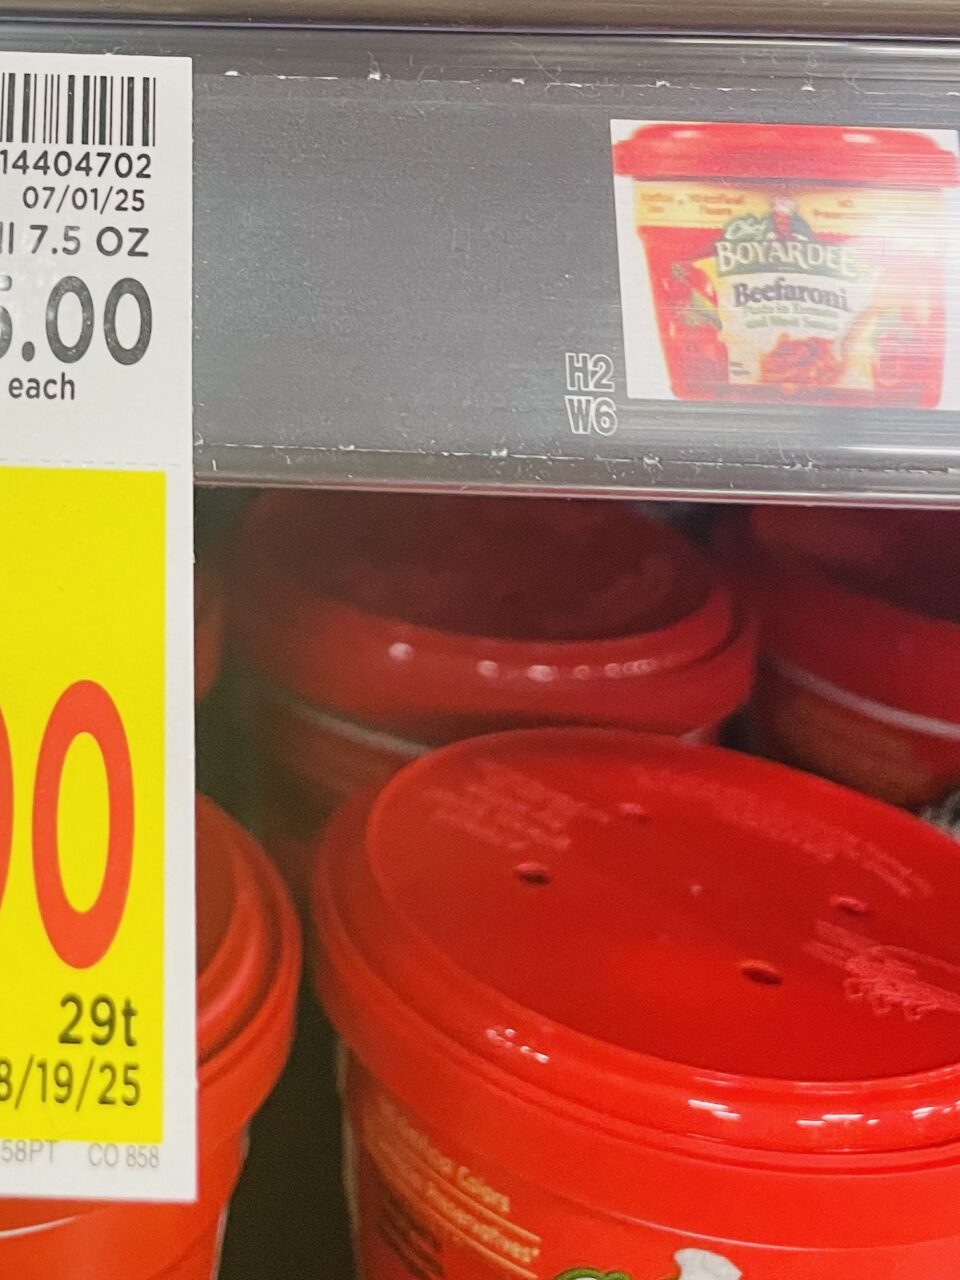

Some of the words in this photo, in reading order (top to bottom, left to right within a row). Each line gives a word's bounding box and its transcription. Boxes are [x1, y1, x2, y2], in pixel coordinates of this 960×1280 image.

[22, 184, 146, 216] 07/01/25
[29, 223, 81, 256] 7.5
[95, 225, 150, 258] OZ
[733, 277, 849, 312] Beefaroni
[8, 371, 76, 400] each
[565, 352, 616, 393] H2
[564, 395, 619, 436] W6
[58, 991, 138, 1048] 29t
[88, 1142, 119, 1168] CO
[125, 1144, 160, 1169] 858
